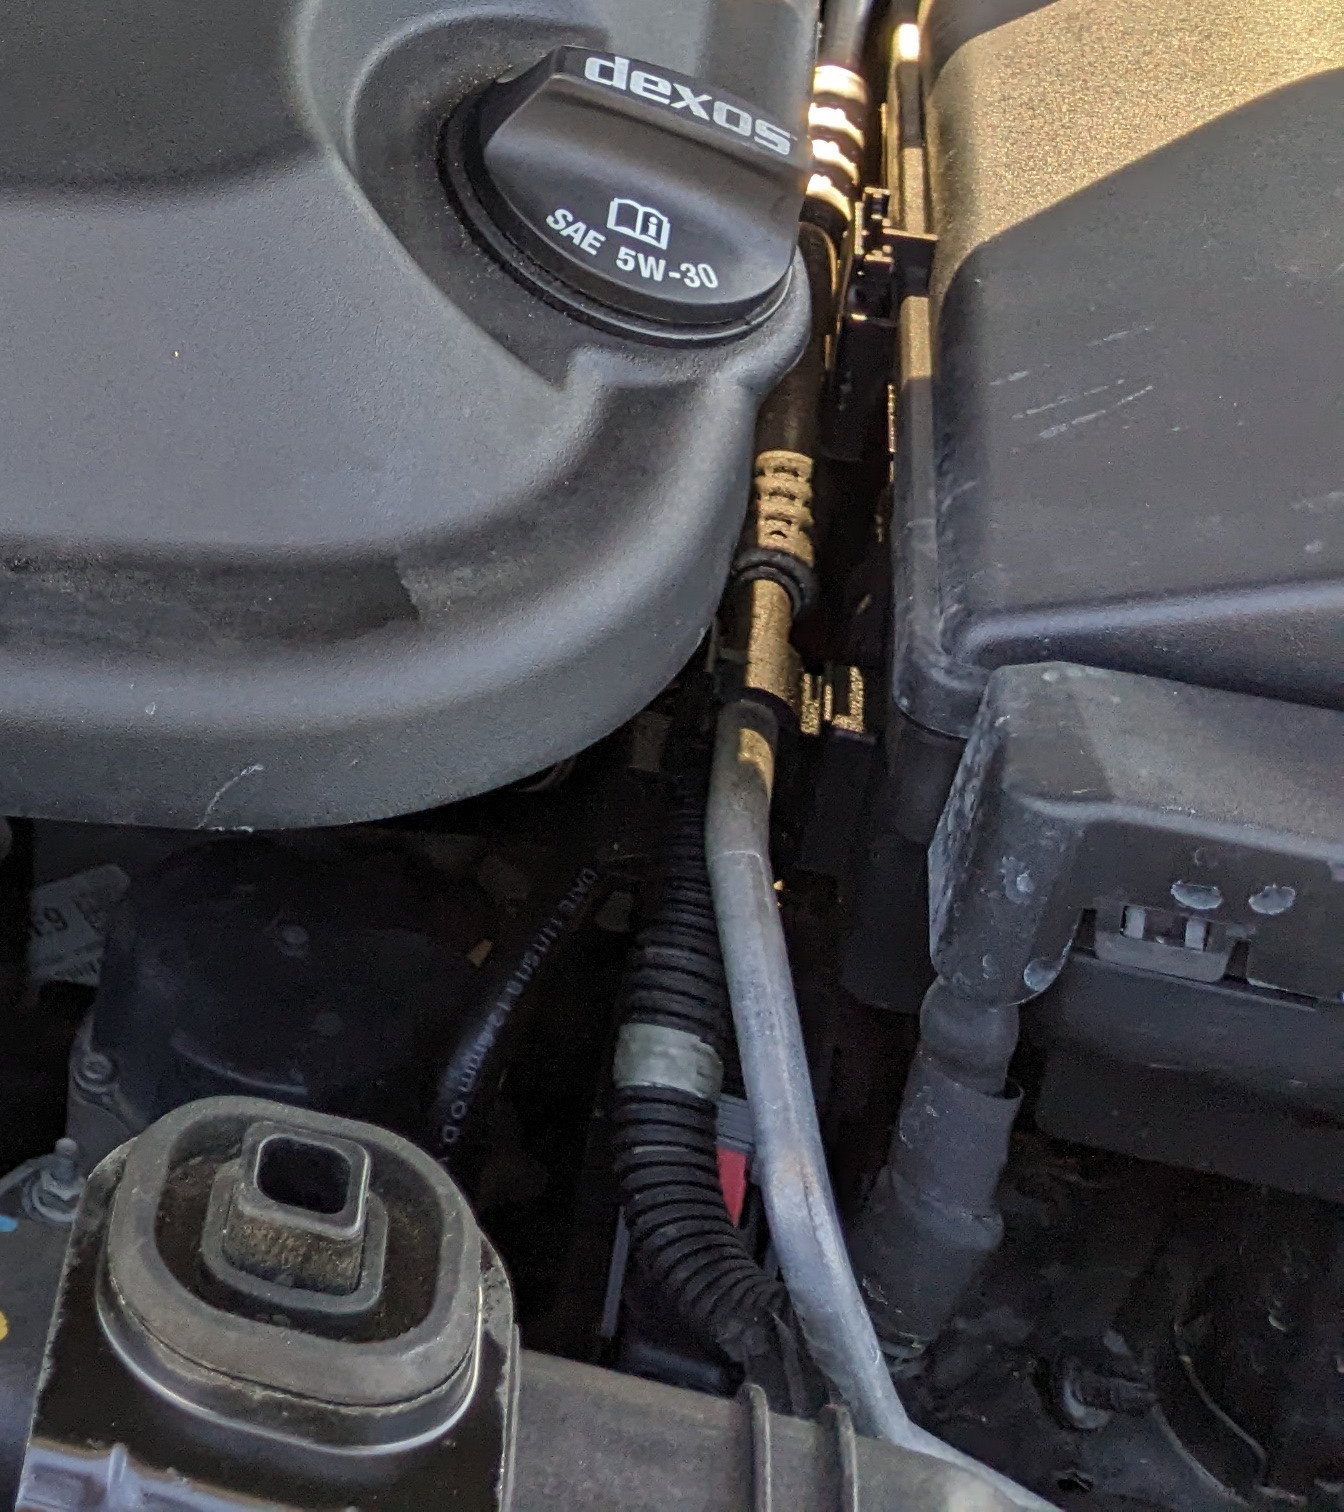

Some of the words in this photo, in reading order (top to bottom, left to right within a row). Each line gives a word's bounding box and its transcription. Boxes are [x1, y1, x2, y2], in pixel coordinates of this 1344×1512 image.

[584, 55, 792, 156] dexos
[545, 208, 607, 256] SAE
[615, 246, 719, 290] 5W-30
